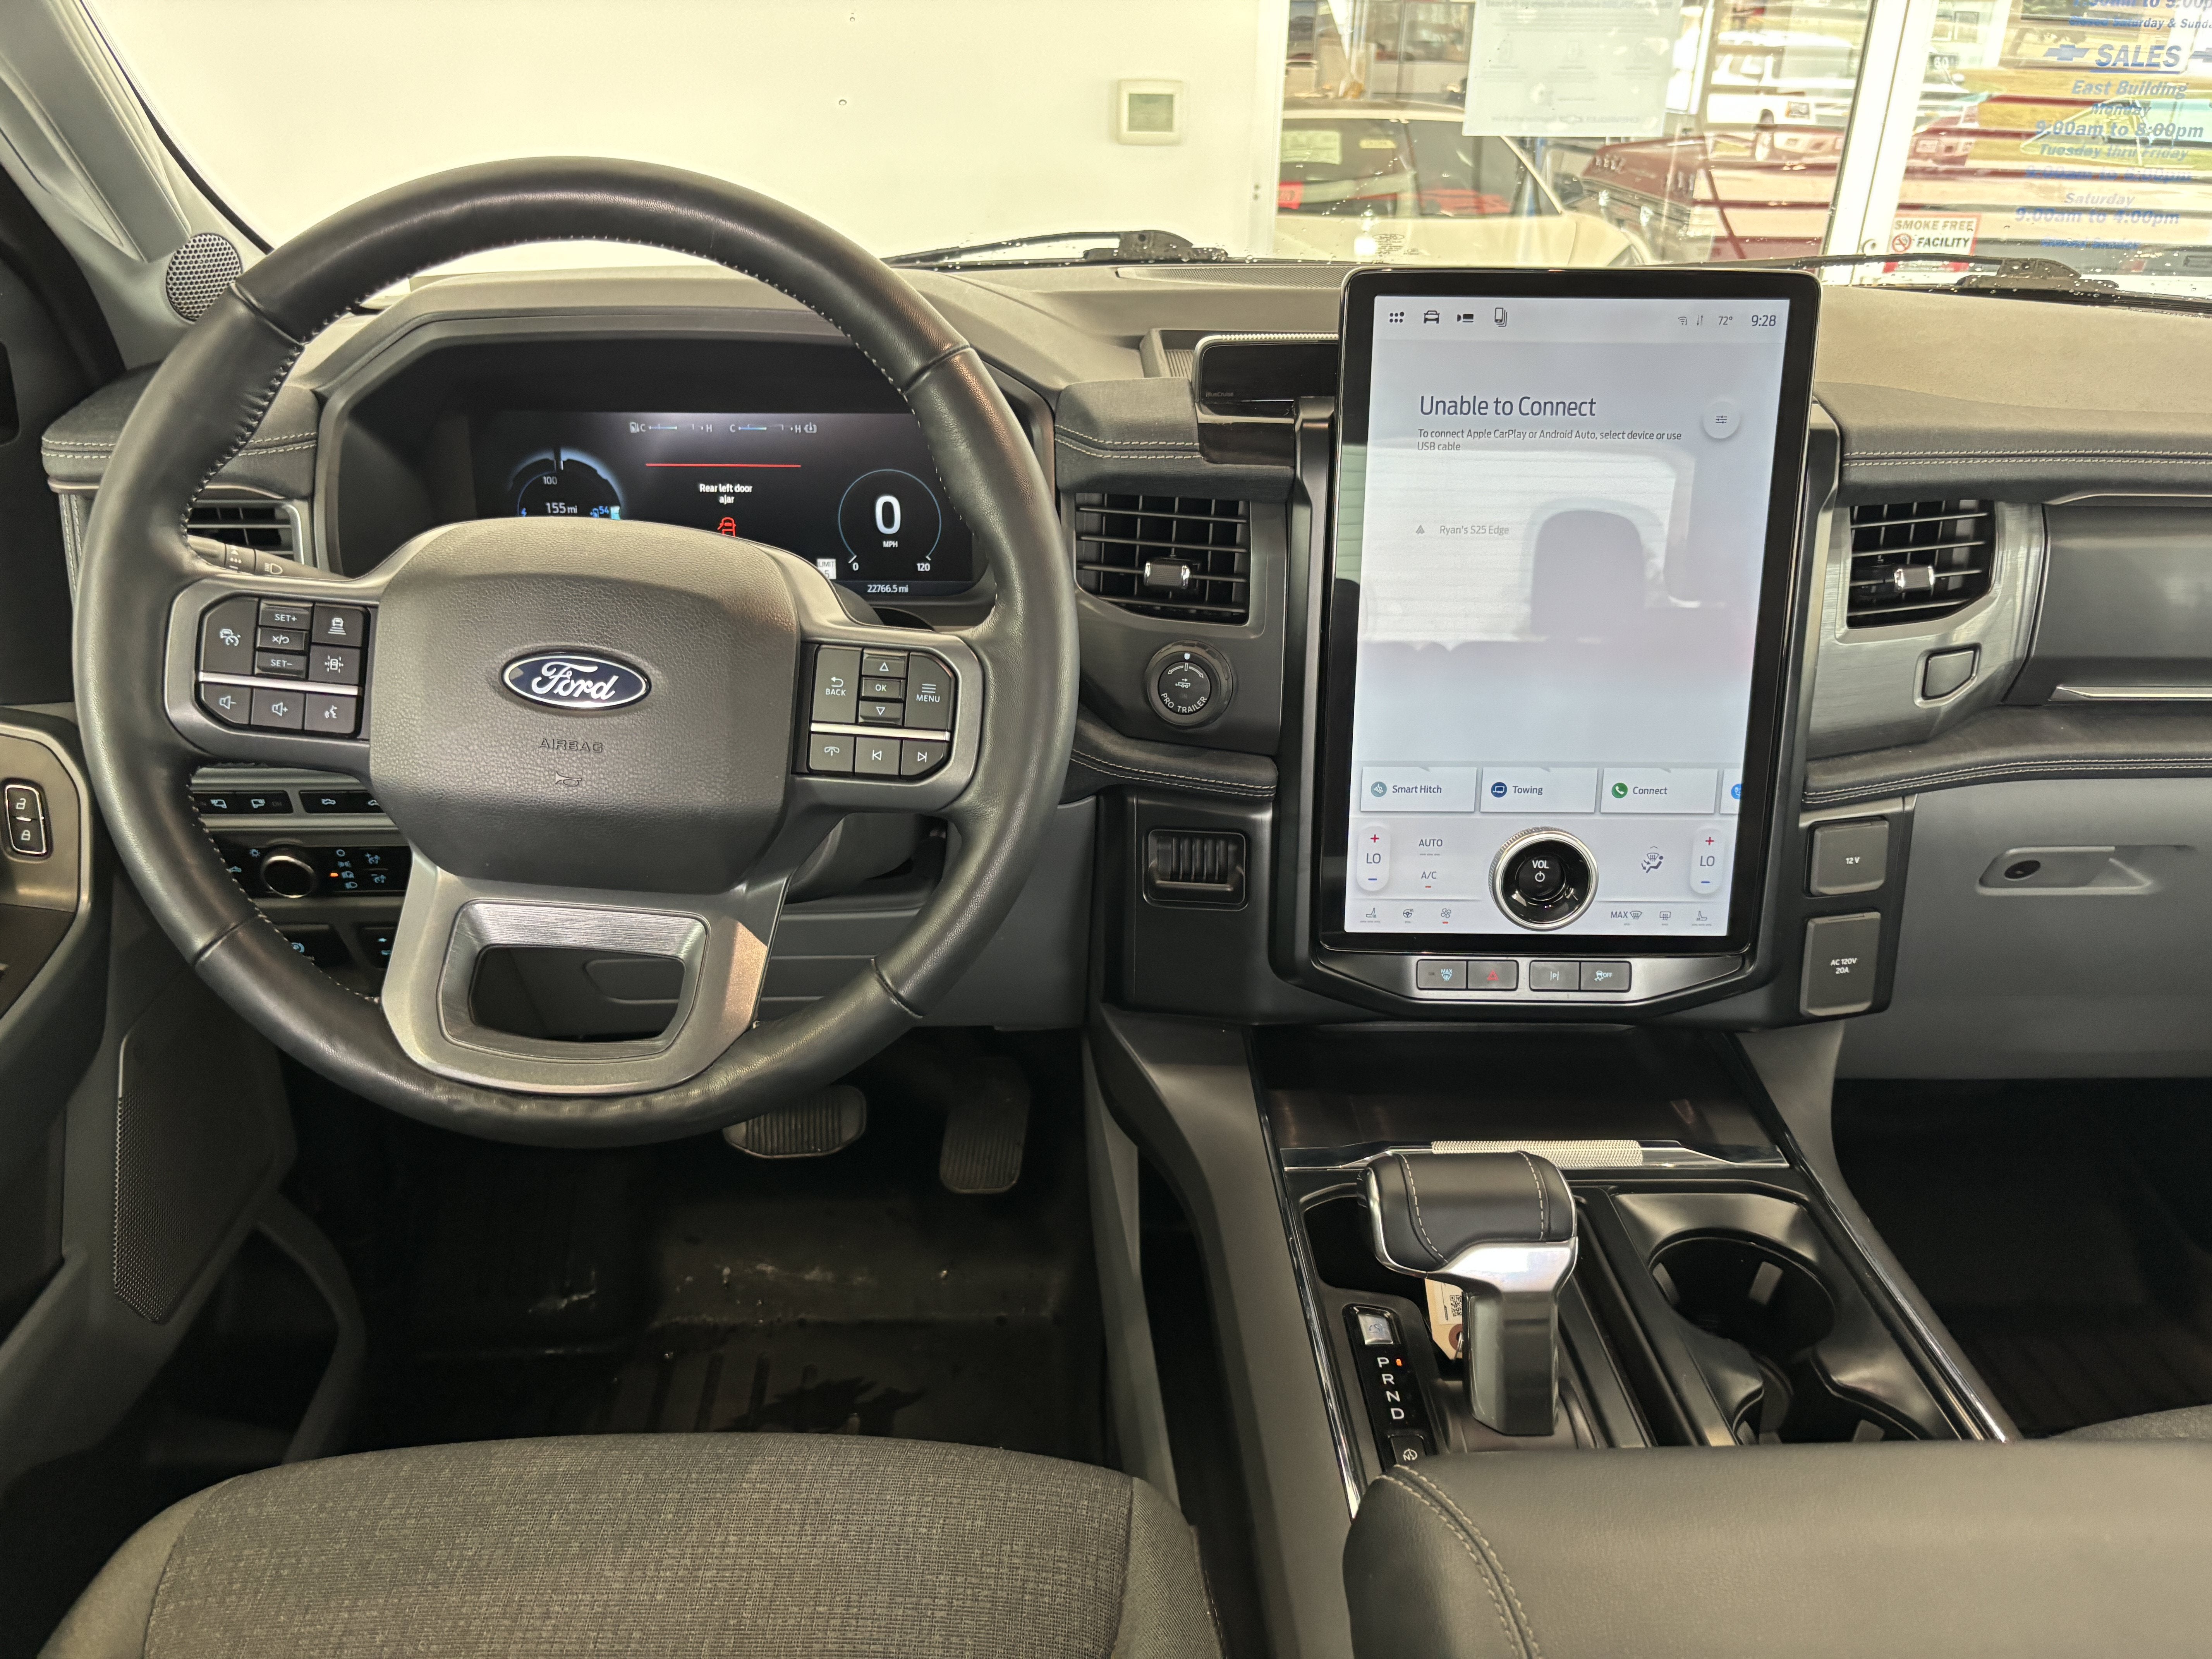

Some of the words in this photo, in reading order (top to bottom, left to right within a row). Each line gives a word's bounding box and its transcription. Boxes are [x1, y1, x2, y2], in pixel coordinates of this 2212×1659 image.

[2112, 17, 2165, 30] Saturday
[2167, 18, 2176, 28] &
[2095, 44, 2182, 67] SALES
[2071, 80, 2112, 95] East
[2115, 80, 2188, 100] Building
[2091, 103, 2151, 117] Monday
[2035, 120, 2104, 136] 9:00am
[2110, 122, 2129, 136] to
[2135, 122, 2204, 140] 8:00pm
[2039, 143, 2102, 159] Tuesday
[2107, 146, 2138, 158] thru
[2141, 148, 2189, 161] Friday
[2064, 192, 2136, 208] Saturday
[2014, 207, 2083, 223] 9:00am
[2089, 210, 2107, 223] to
[2113, 210, 2181, 227] 4:00pm
[1894, 220, 1940, 230] SMOKE
[1942, 220, 1974, 230] FREE
[1917, 237, 1970, 247] FACILITY
[1751, 314, 1777, 326] 9:28
[1420, 395, 1489, 416] Unable
[1493, 397, 1513, 416] to
[1518, 396, 1596, 417] Connect
[1418, 429, 1428, 438] To
[1430, 429, 1465, 438] connect
[1467, 429, 1492, 440] Apple
[1493, 429, 1527, 440] CarPlay
[1528, 431, 1537, 439] or
[1539, 429, 1573, 439] Android
[1574, 430, 1598, 440] Auto,
[1600, 430, 1626, 440] select
[1627, 430, 1654, 440] device
[1656, 432, 1665, 440] or
[1667, 432, 1682, 440] use
[1417, 441, 1435, 451] USB
[1437, 441, 1461, 451] cable
[543, 476, 558, 485] 100
[699, 484, 718, 493] Rear
[719, 483, 733, 493] left
[734, 484, 753, 493] door
[719, 494, 735, 505] ajar
[546, 502, 566, 514] 155
[567, 505, 578, 514] mi
[599, 505, 610, 515] 54
[875, 495, 901, 535] 0
[1439, 525, 1468, 536] Ryan's
[1470, 525, 1487, 534] S25
[1488, 525, 1510, 536] Edge
[852, 563, 859, 571] 0
[916, 563, 931, 572] 120
[867, 584, 898, 593] 22766.5
[898, 585, 908, 593] mi
[275, 613, 297, 622] SET+
[531, 661, 619, 701] Ford
[825, 688, 846, 696] BACK
[916, 694, 940, 703] MENU
[1161, 693, 1174, 708] PRO
[1177, 696, 1207, 713] TRAILER
[539, 738, 603, 753] AIRBAG
[1392, 785, 1418, 793] Smart
[1420, 785, 1442, 793] Hitch
[1512, 785, 1543, 795] Towing
[1632, 786, 1668, 796] Connect
[1419, 839, 1443, 847] AUTO
[1366, 853, 1381, 864] LO
[1700, 855, 1715, 867] LO
[1532, 860, 1549, 869] VOL
[1421, 871, 1437, 879] A/C
[1610, 911, 1628, 919] MAX
[1377, 1357, 1389, 1368] P
[1381, 1373, 1395, 1385] R
[1386, 1390, 1400, 1402] N
[1390, 1408, 1405, 1420] D
